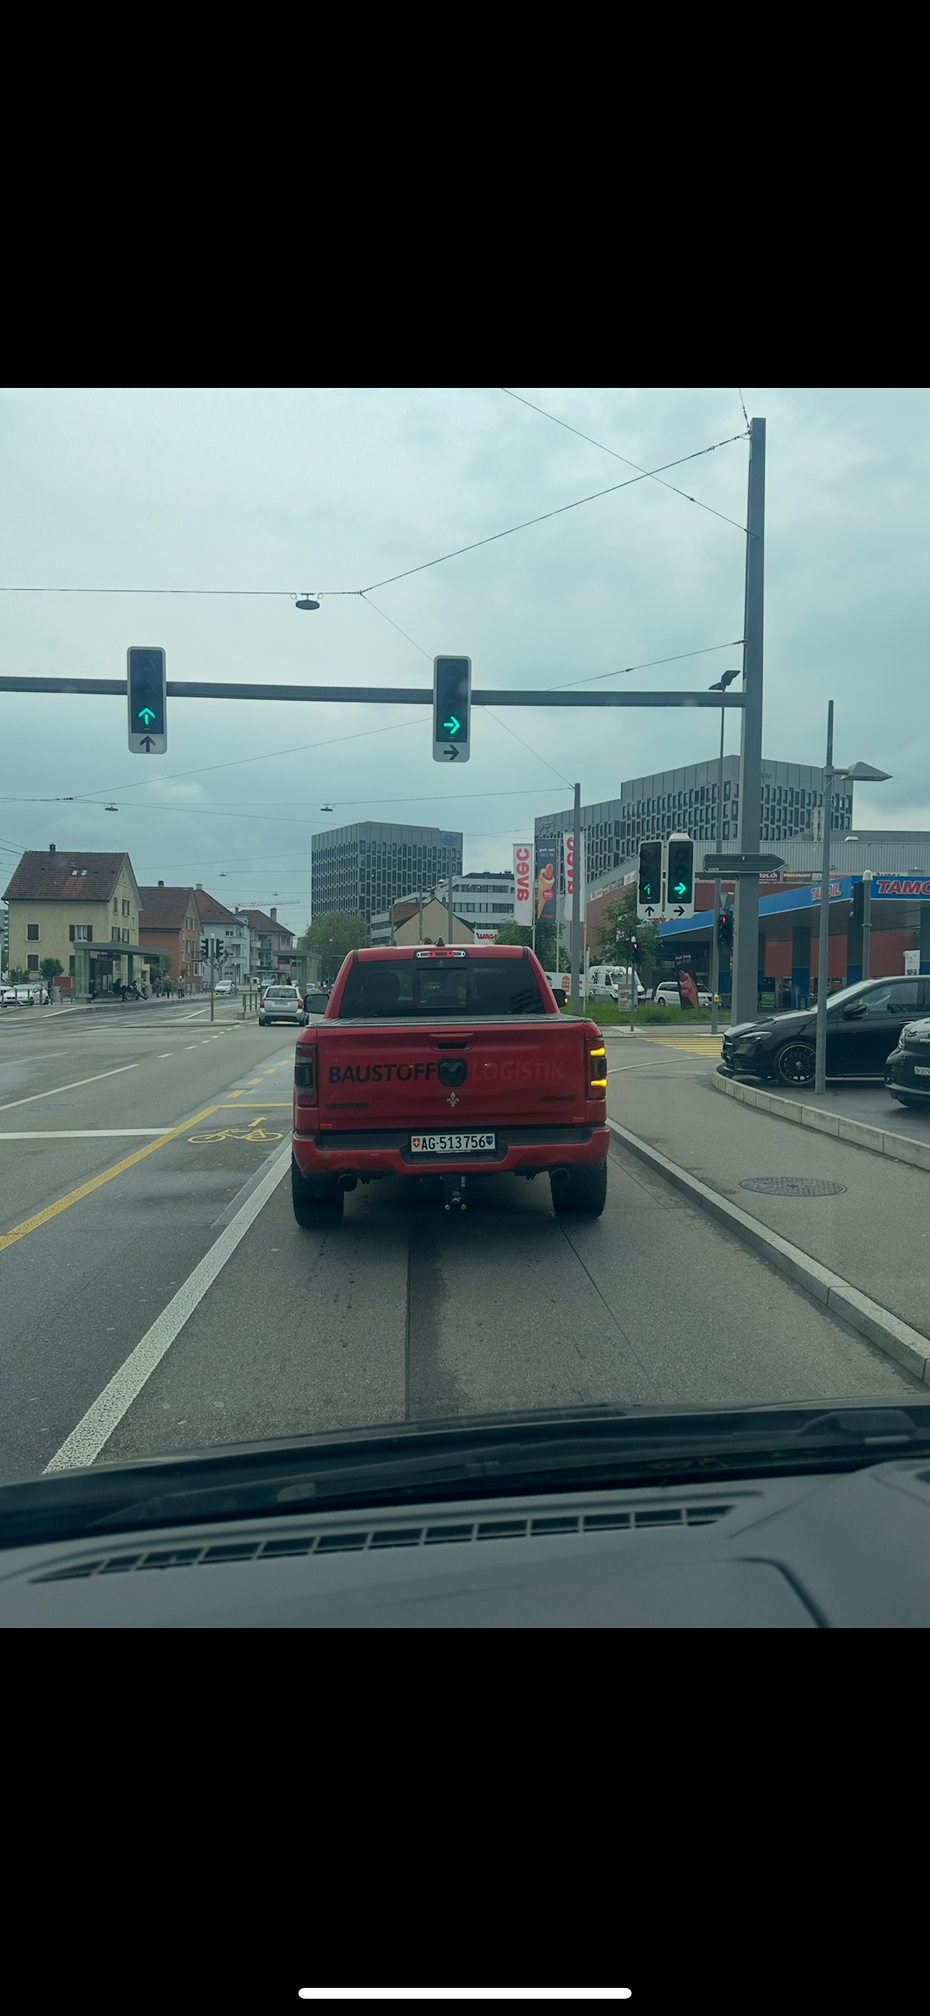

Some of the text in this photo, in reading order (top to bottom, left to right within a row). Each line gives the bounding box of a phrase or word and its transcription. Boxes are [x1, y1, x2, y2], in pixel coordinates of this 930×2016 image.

[811, 883, 841, 901] TAOIL
[328, 1061, 564, 1084] BAUSTOFF LOGISTIK
